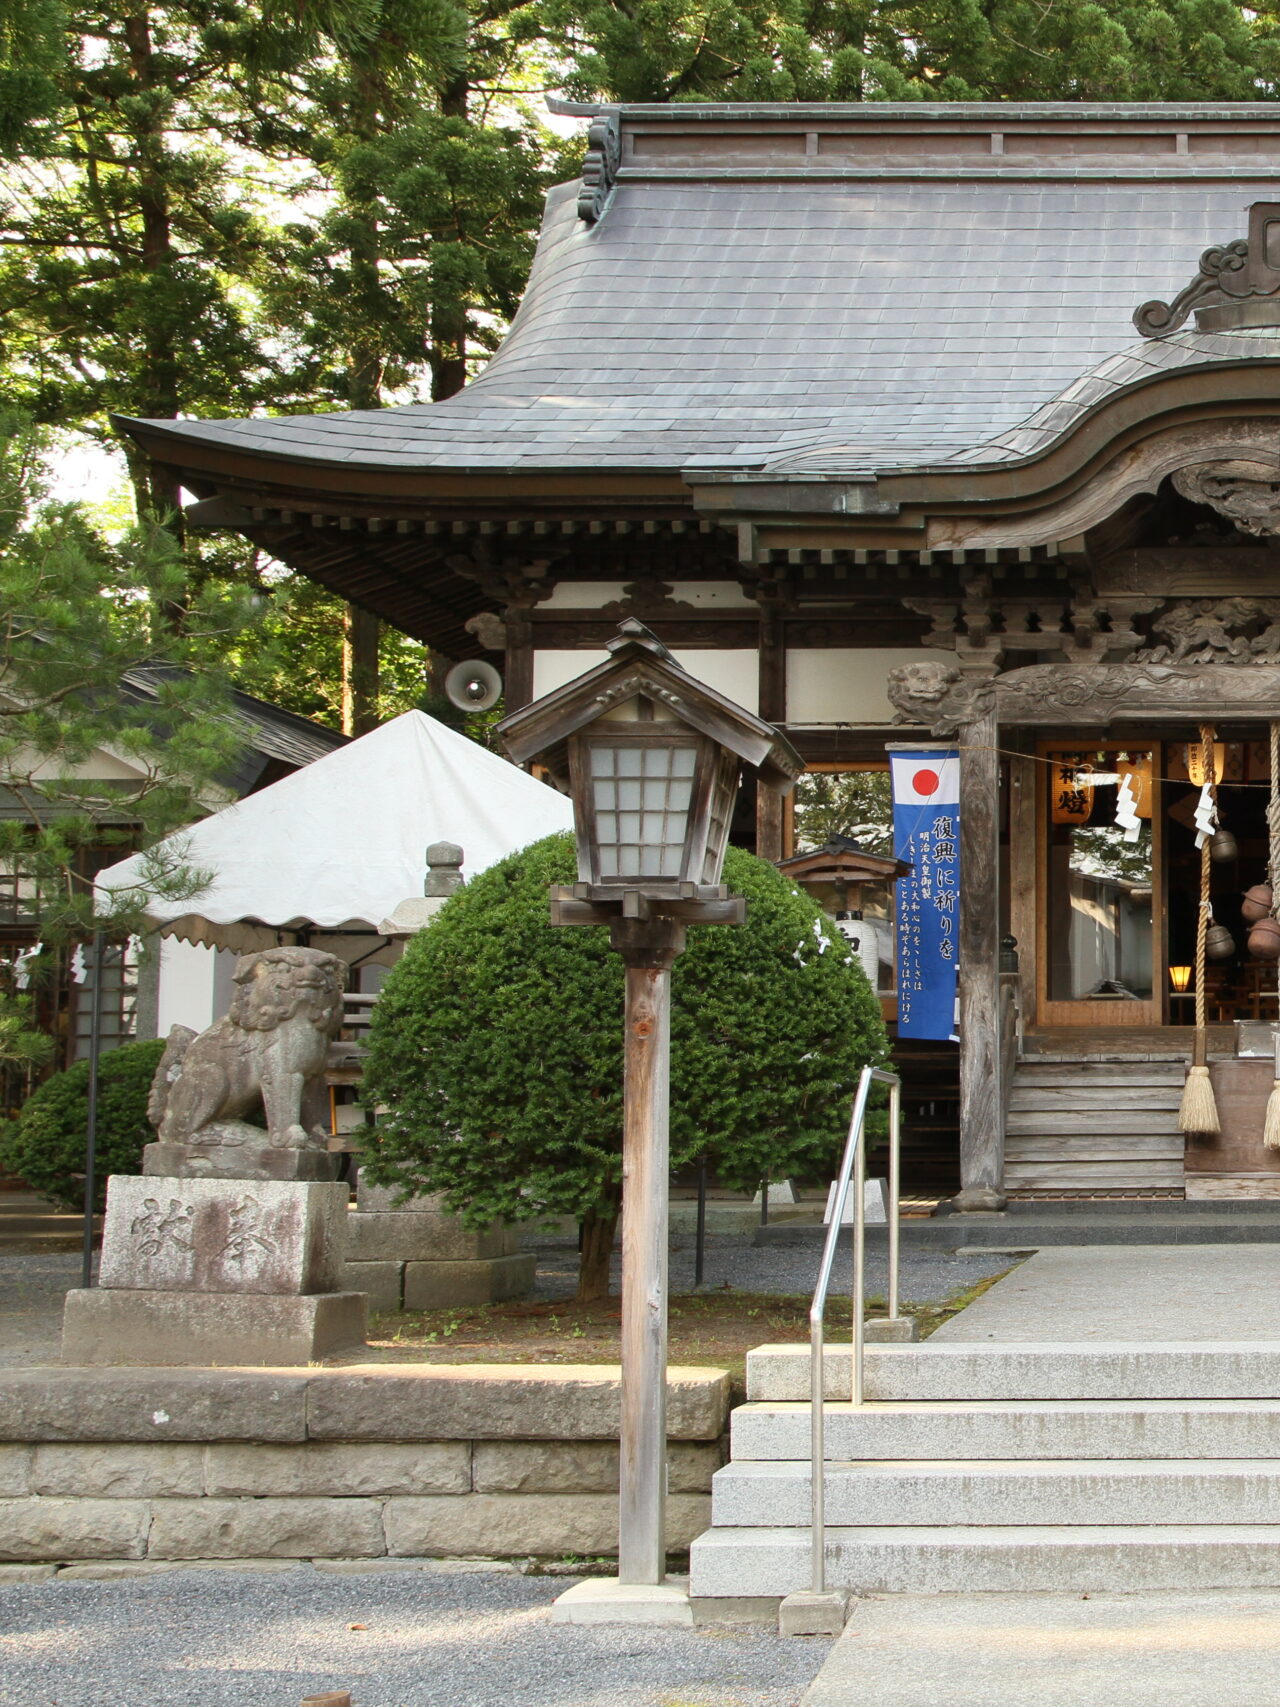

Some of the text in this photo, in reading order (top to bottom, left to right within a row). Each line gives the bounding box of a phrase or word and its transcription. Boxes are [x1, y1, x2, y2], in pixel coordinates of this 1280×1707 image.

[919, 831, 932, 899] 明治天皇御製
[931, 815, 957, 960] 復興に祈りを
